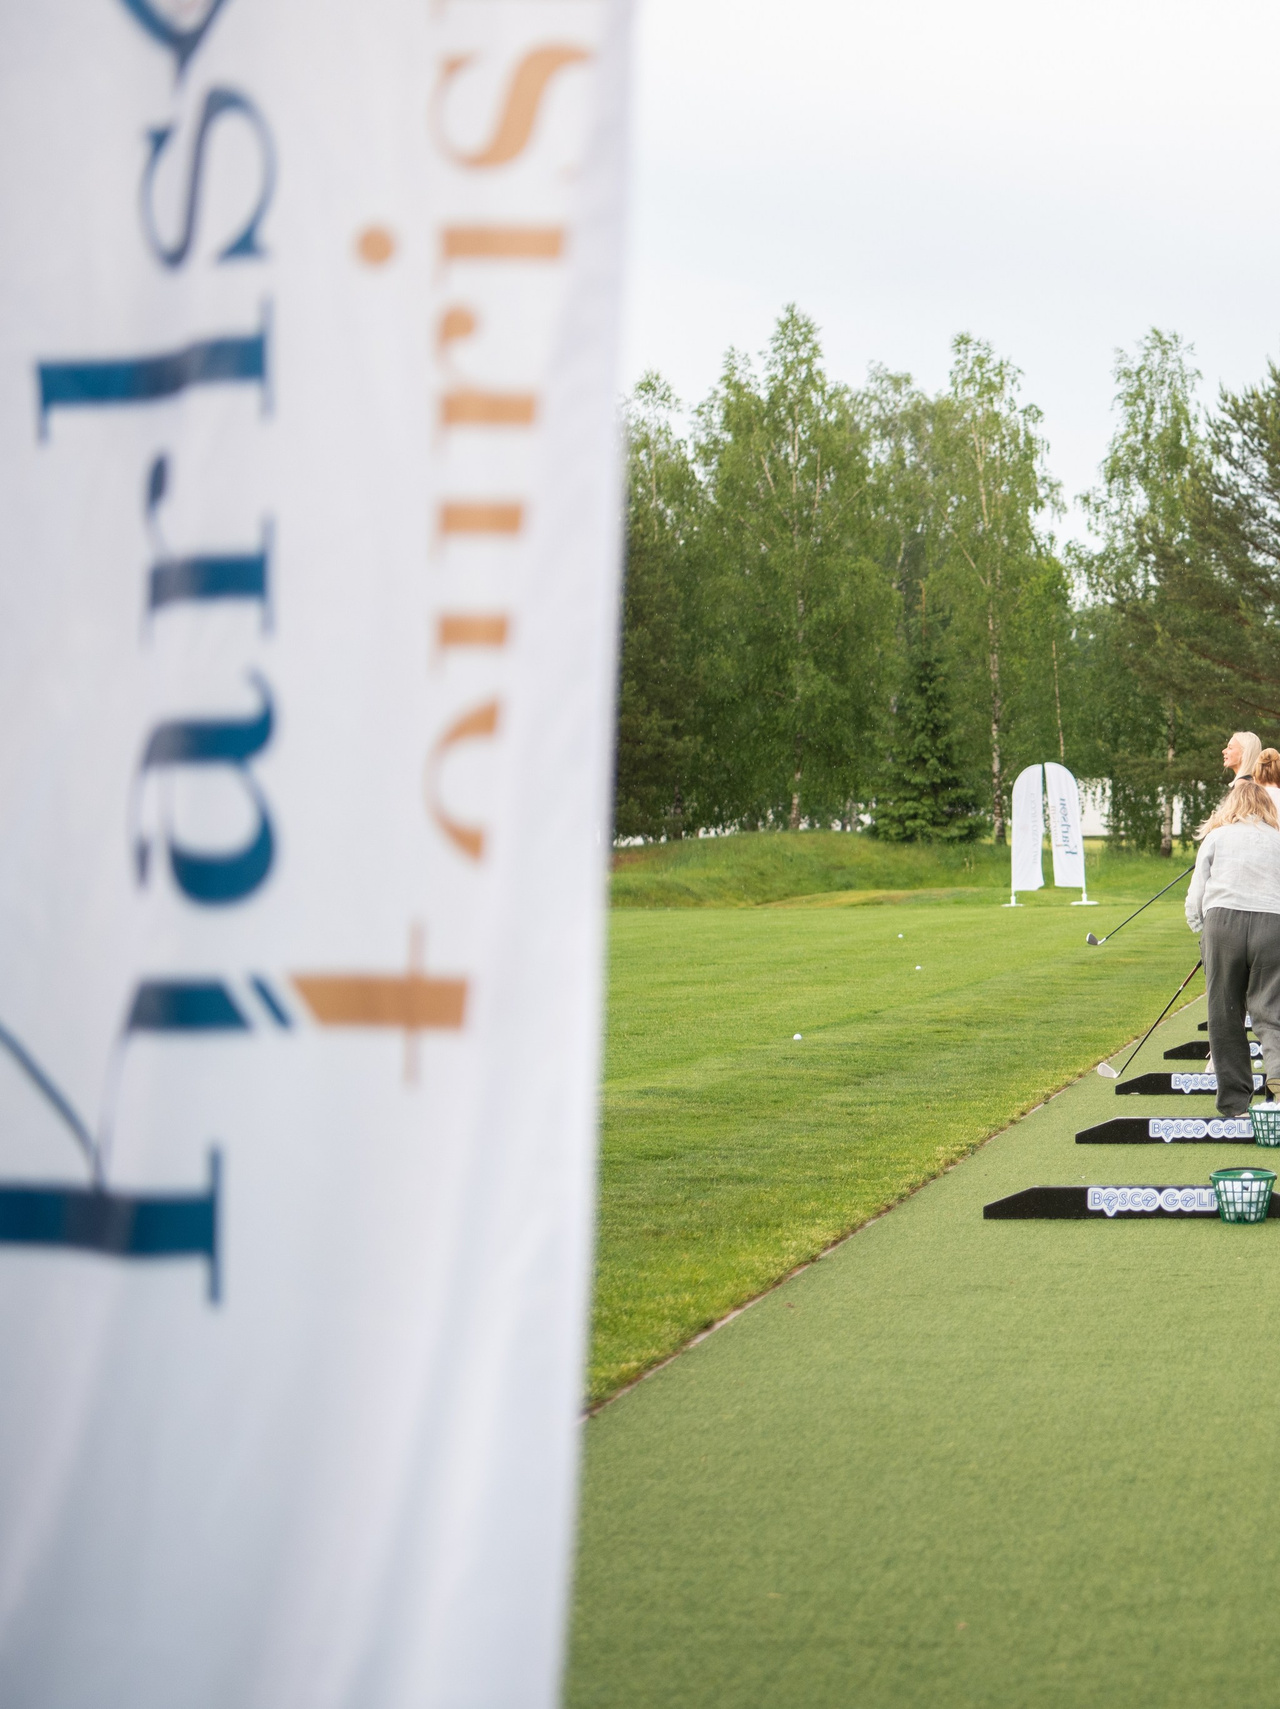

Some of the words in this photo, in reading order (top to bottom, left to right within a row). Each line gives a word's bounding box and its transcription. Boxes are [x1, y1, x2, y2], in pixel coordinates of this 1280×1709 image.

[1151, 1121, 1206, 1137] BOSCO
[1209, 1121, 1254, 1135] GOLF
[1090, 1190, 1158, 1210] BOSCO
[1163, 1190, 1218, 1207] GOLF
